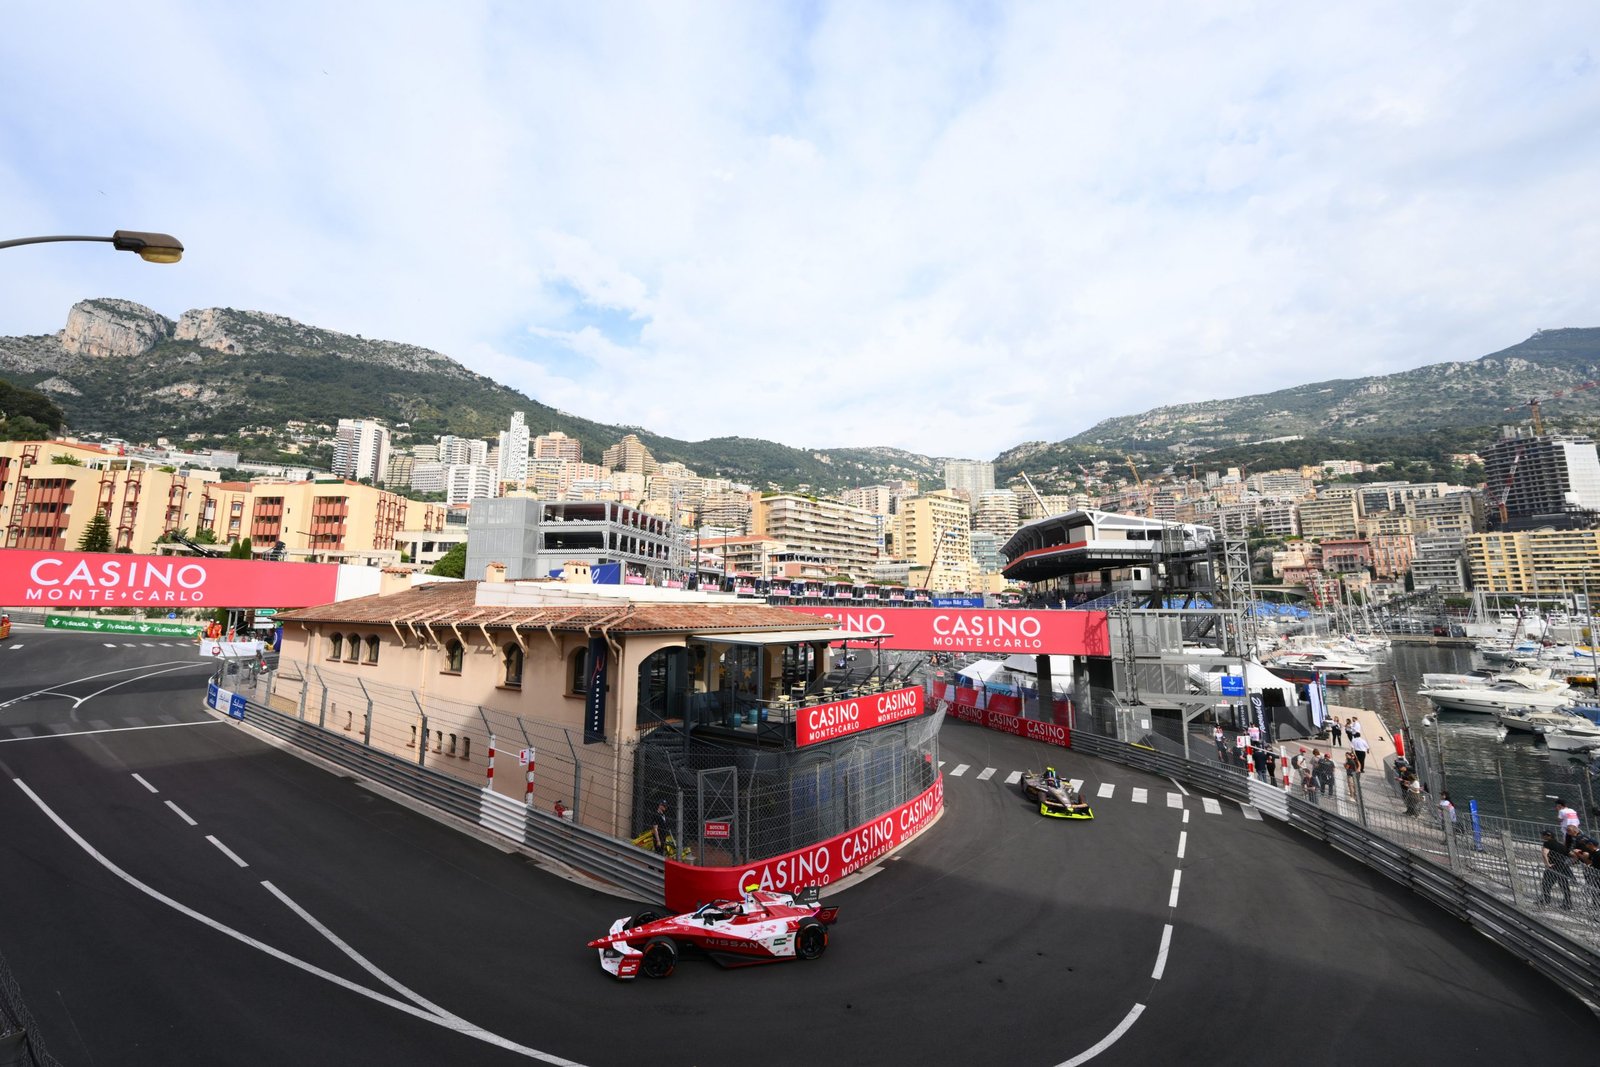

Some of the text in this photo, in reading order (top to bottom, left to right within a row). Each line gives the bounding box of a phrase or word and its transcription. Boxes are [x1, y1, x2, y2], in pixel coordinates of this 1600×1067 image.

[30, 558, 206, 588] CASINO
[25, 588, 204, 602] MONTE CARLO
[933, 615, 1041, 637] CASINO
[933, 637, 1042, 649] MONTE CARLO
[877, 690, 916, 714] CASINO
[957, 703, 983, 720] CASINO
[809, 702, 859, 730] CASINO
[878, 706, 917, 723] MONTE CARLO
[988, 711, 1019, 729] CASINO
[809, 721, 860, 741] MONTE CARLO
[1026, 721, 1065, 740] CASINO
[1027, 732, 1066, 746] MONTE CARLO
[900, 791, 934, 831] CASINO
[841, 817, 894, 864] CASINO
[900, 823, 919, 842] MONTE
[841, 840, 894, 877] MONTE CARLO
[738, 846, 830, 900] CASINO
[705, 937, 759, 949] NISSAN
